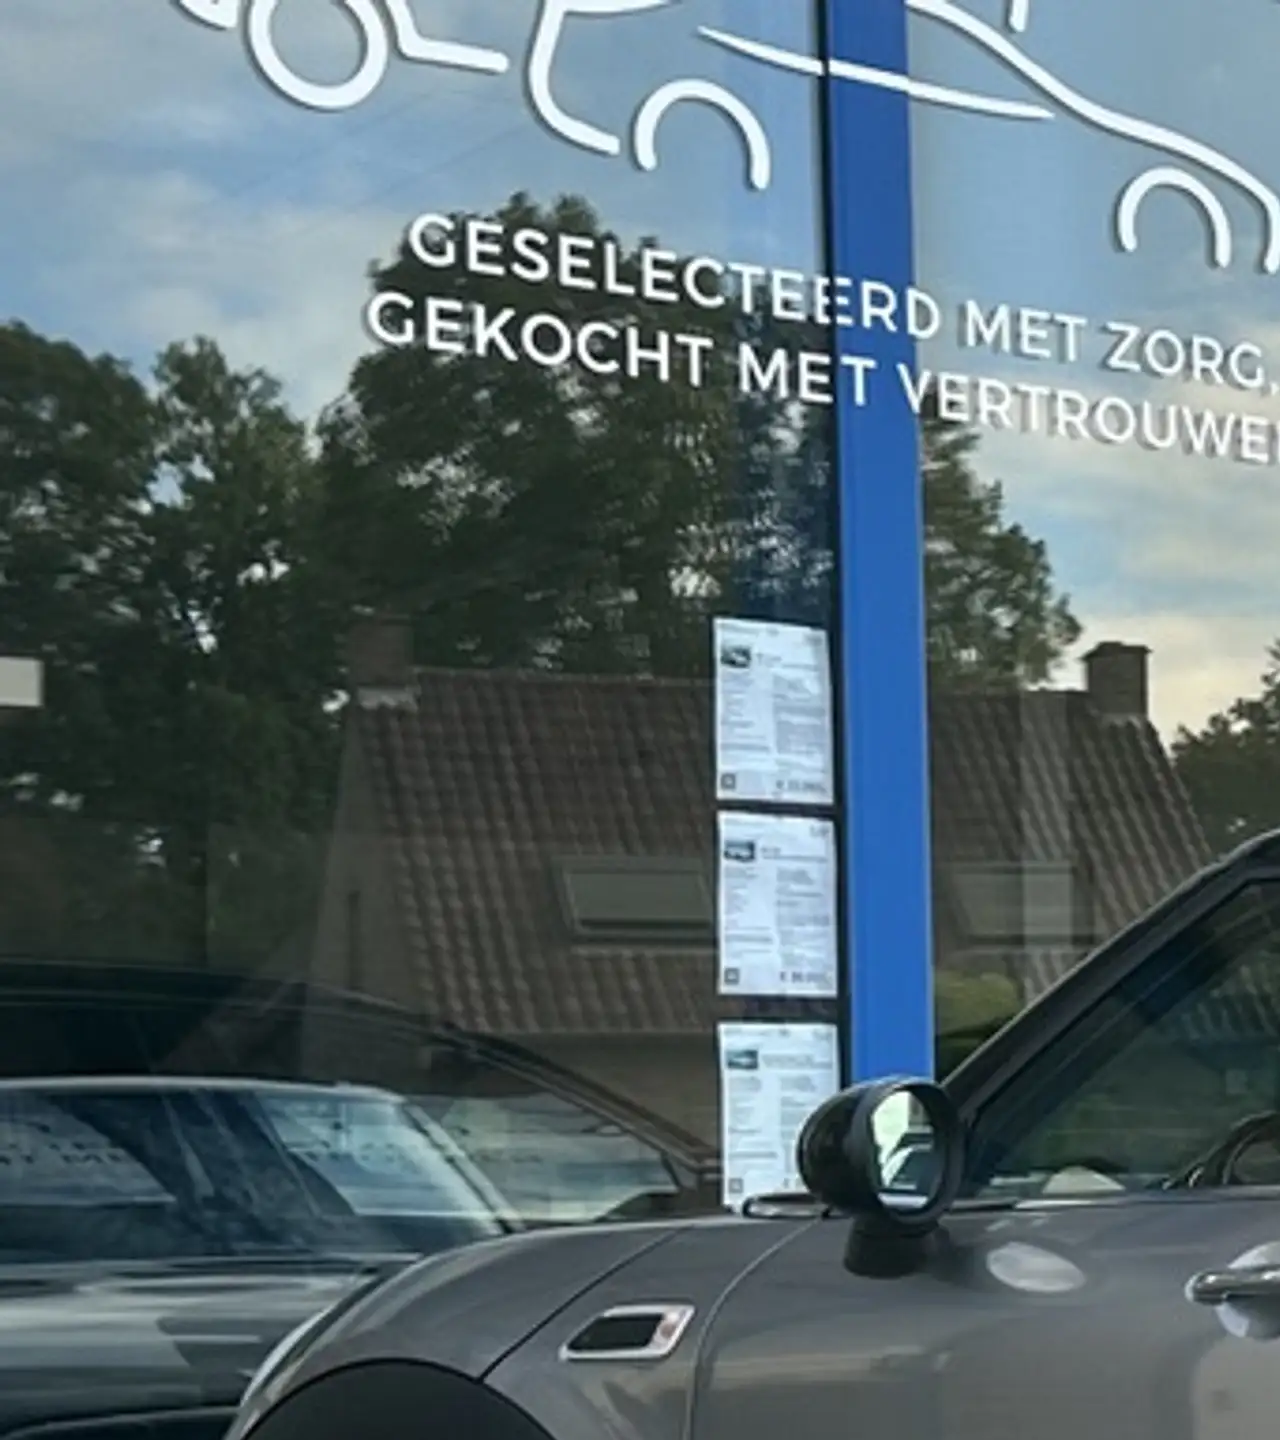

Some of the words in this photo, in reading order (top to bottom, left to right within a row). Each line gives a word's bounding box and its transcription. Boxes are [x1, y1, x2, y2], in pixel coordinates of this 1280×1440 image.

[367, 291, 714, 387] GEKOCHT
[738, 342, 877, 407] MET
[408, 213, 941, 340] GESELECTEERD
[966, 299, 1087, 363] MET
[1106, 322, 1280, 397] ZORG,
